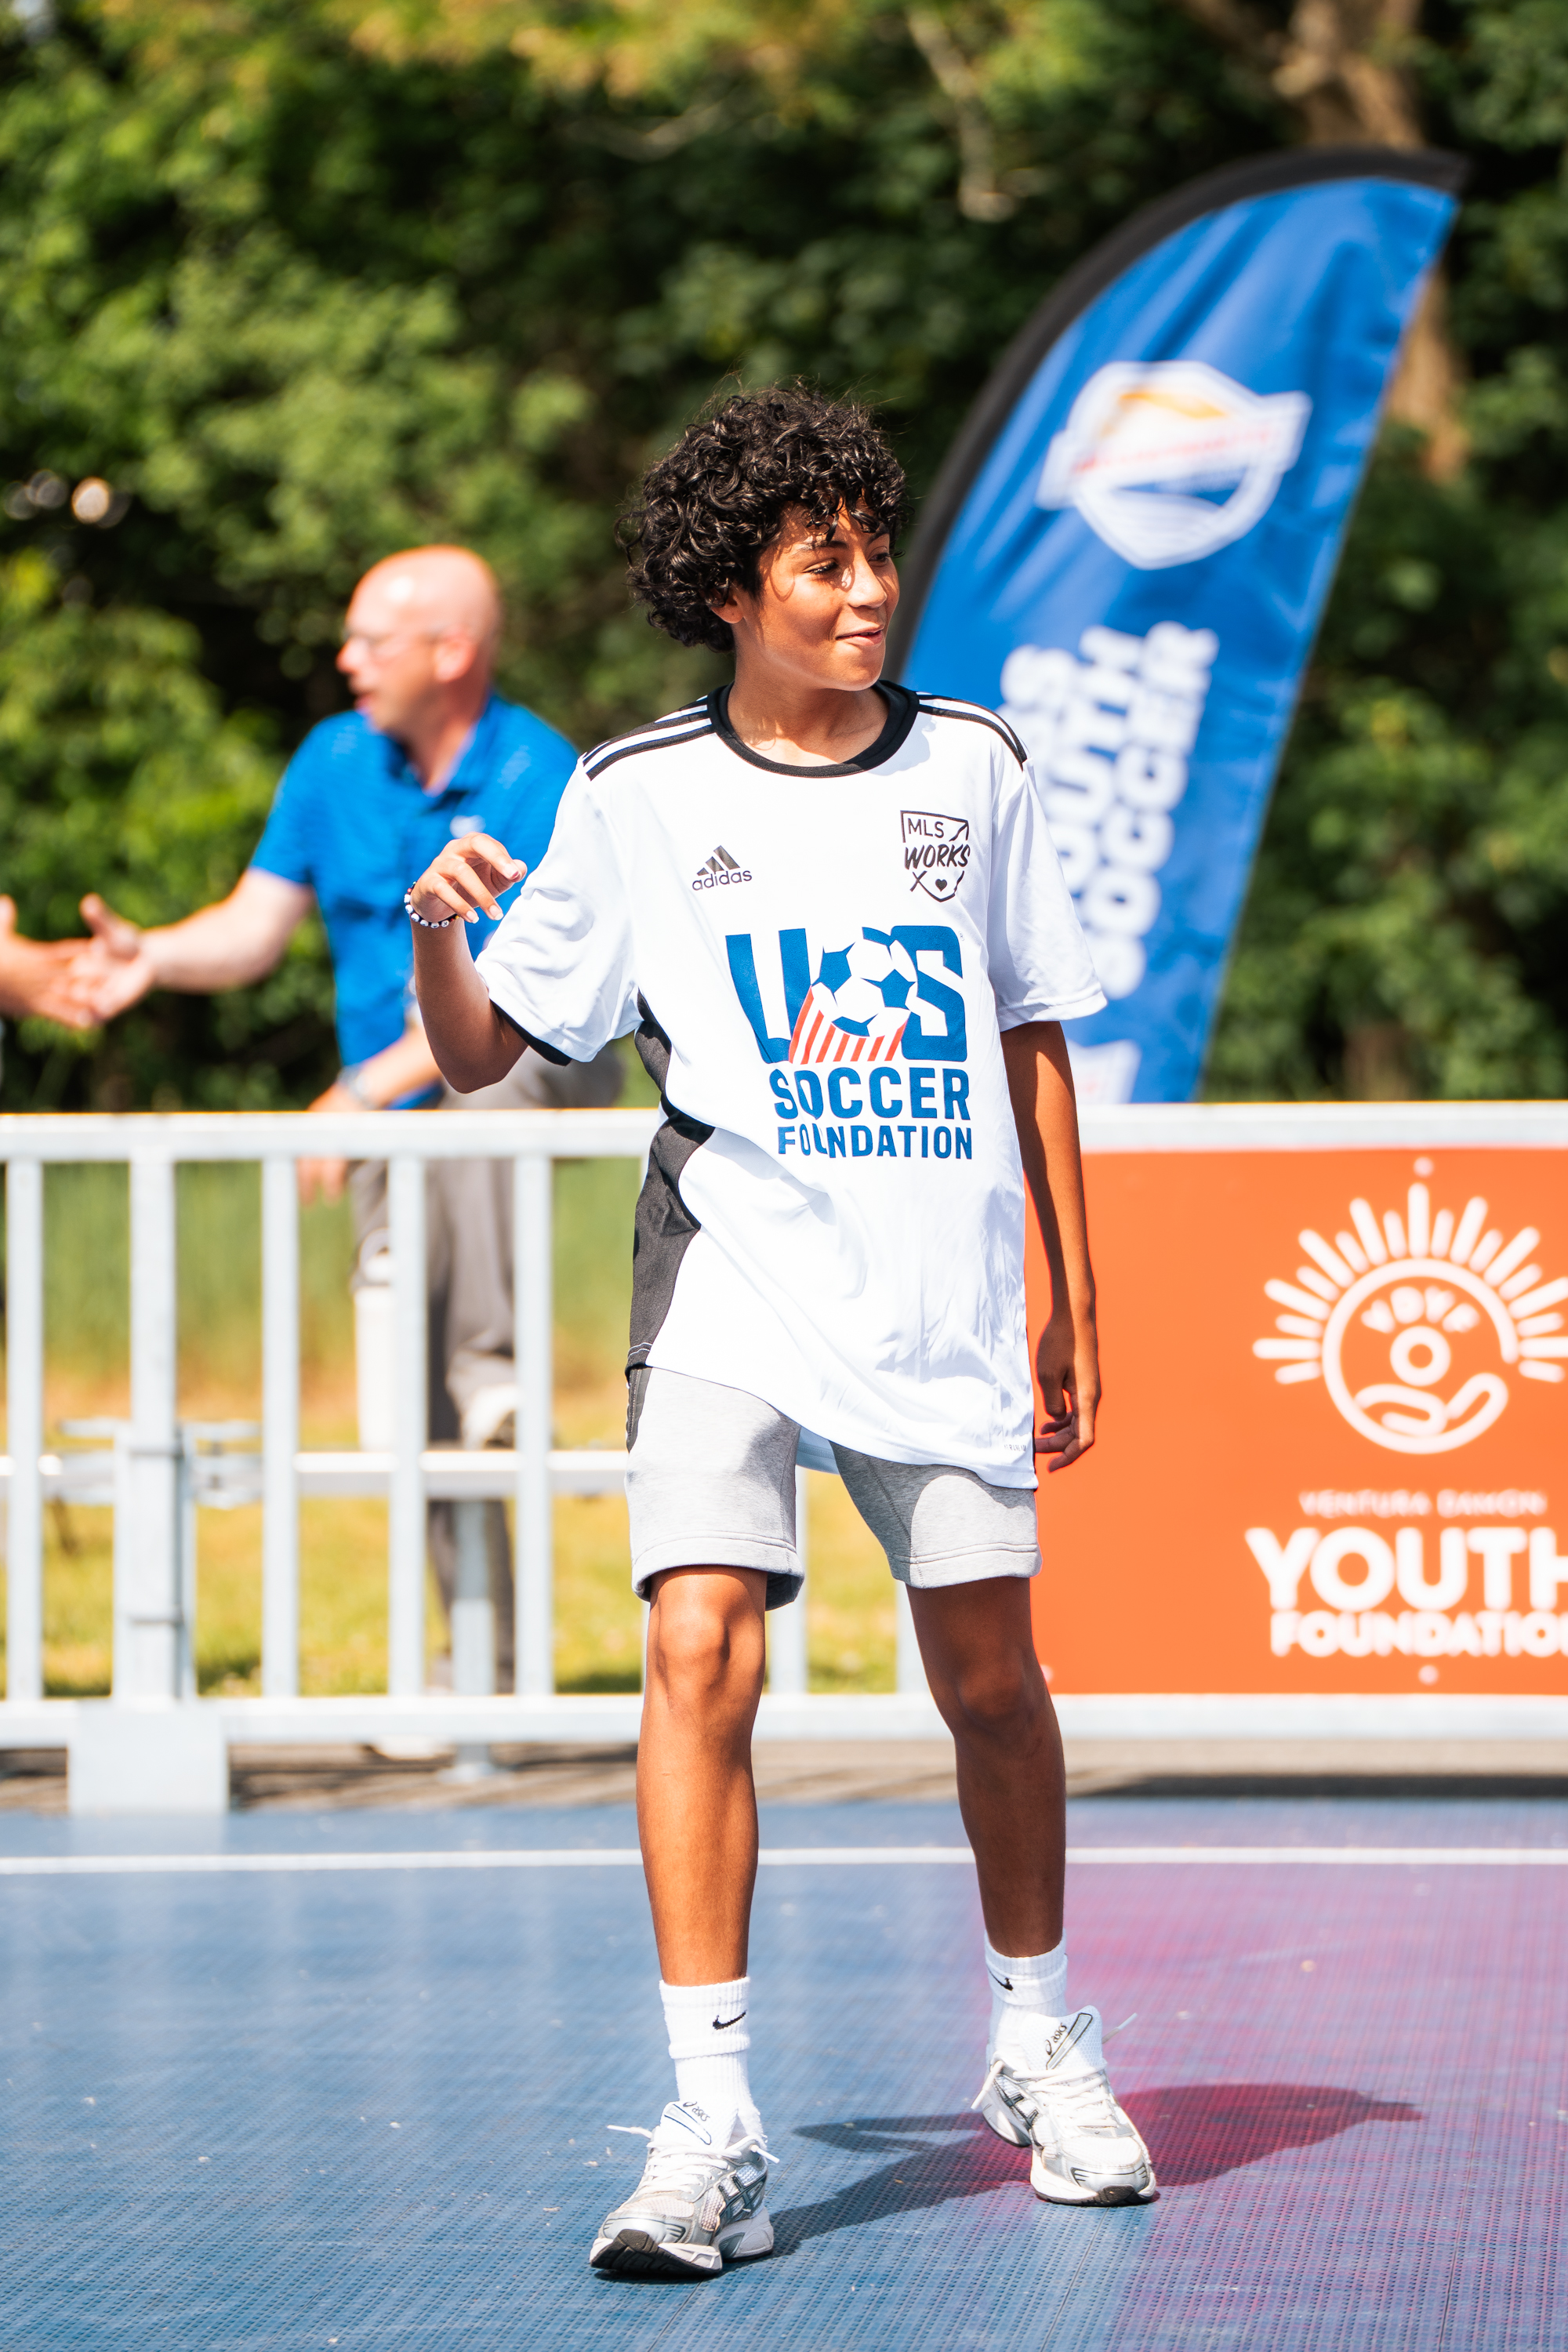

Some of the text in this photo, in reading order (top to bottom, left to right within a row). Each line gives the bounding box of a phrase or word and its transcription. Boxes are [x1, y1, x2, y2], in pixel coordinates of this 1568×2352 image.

[1039, 625, 1143, 894] OUTH
[908, 818, 944, 838] MLS
[904, 844, 971, 870] WORKS
[691, 870, 753, 891] adidas
[769, 1066, 971, 1120] SOCCER
[1245, 1526, 1568, 1613] YOUTH
[1271, 1610, 1568, 1657] FOUNDATIO
[1051, 2023, 1067, 2043] asics
[691, 2106, 710, 2122] asics
